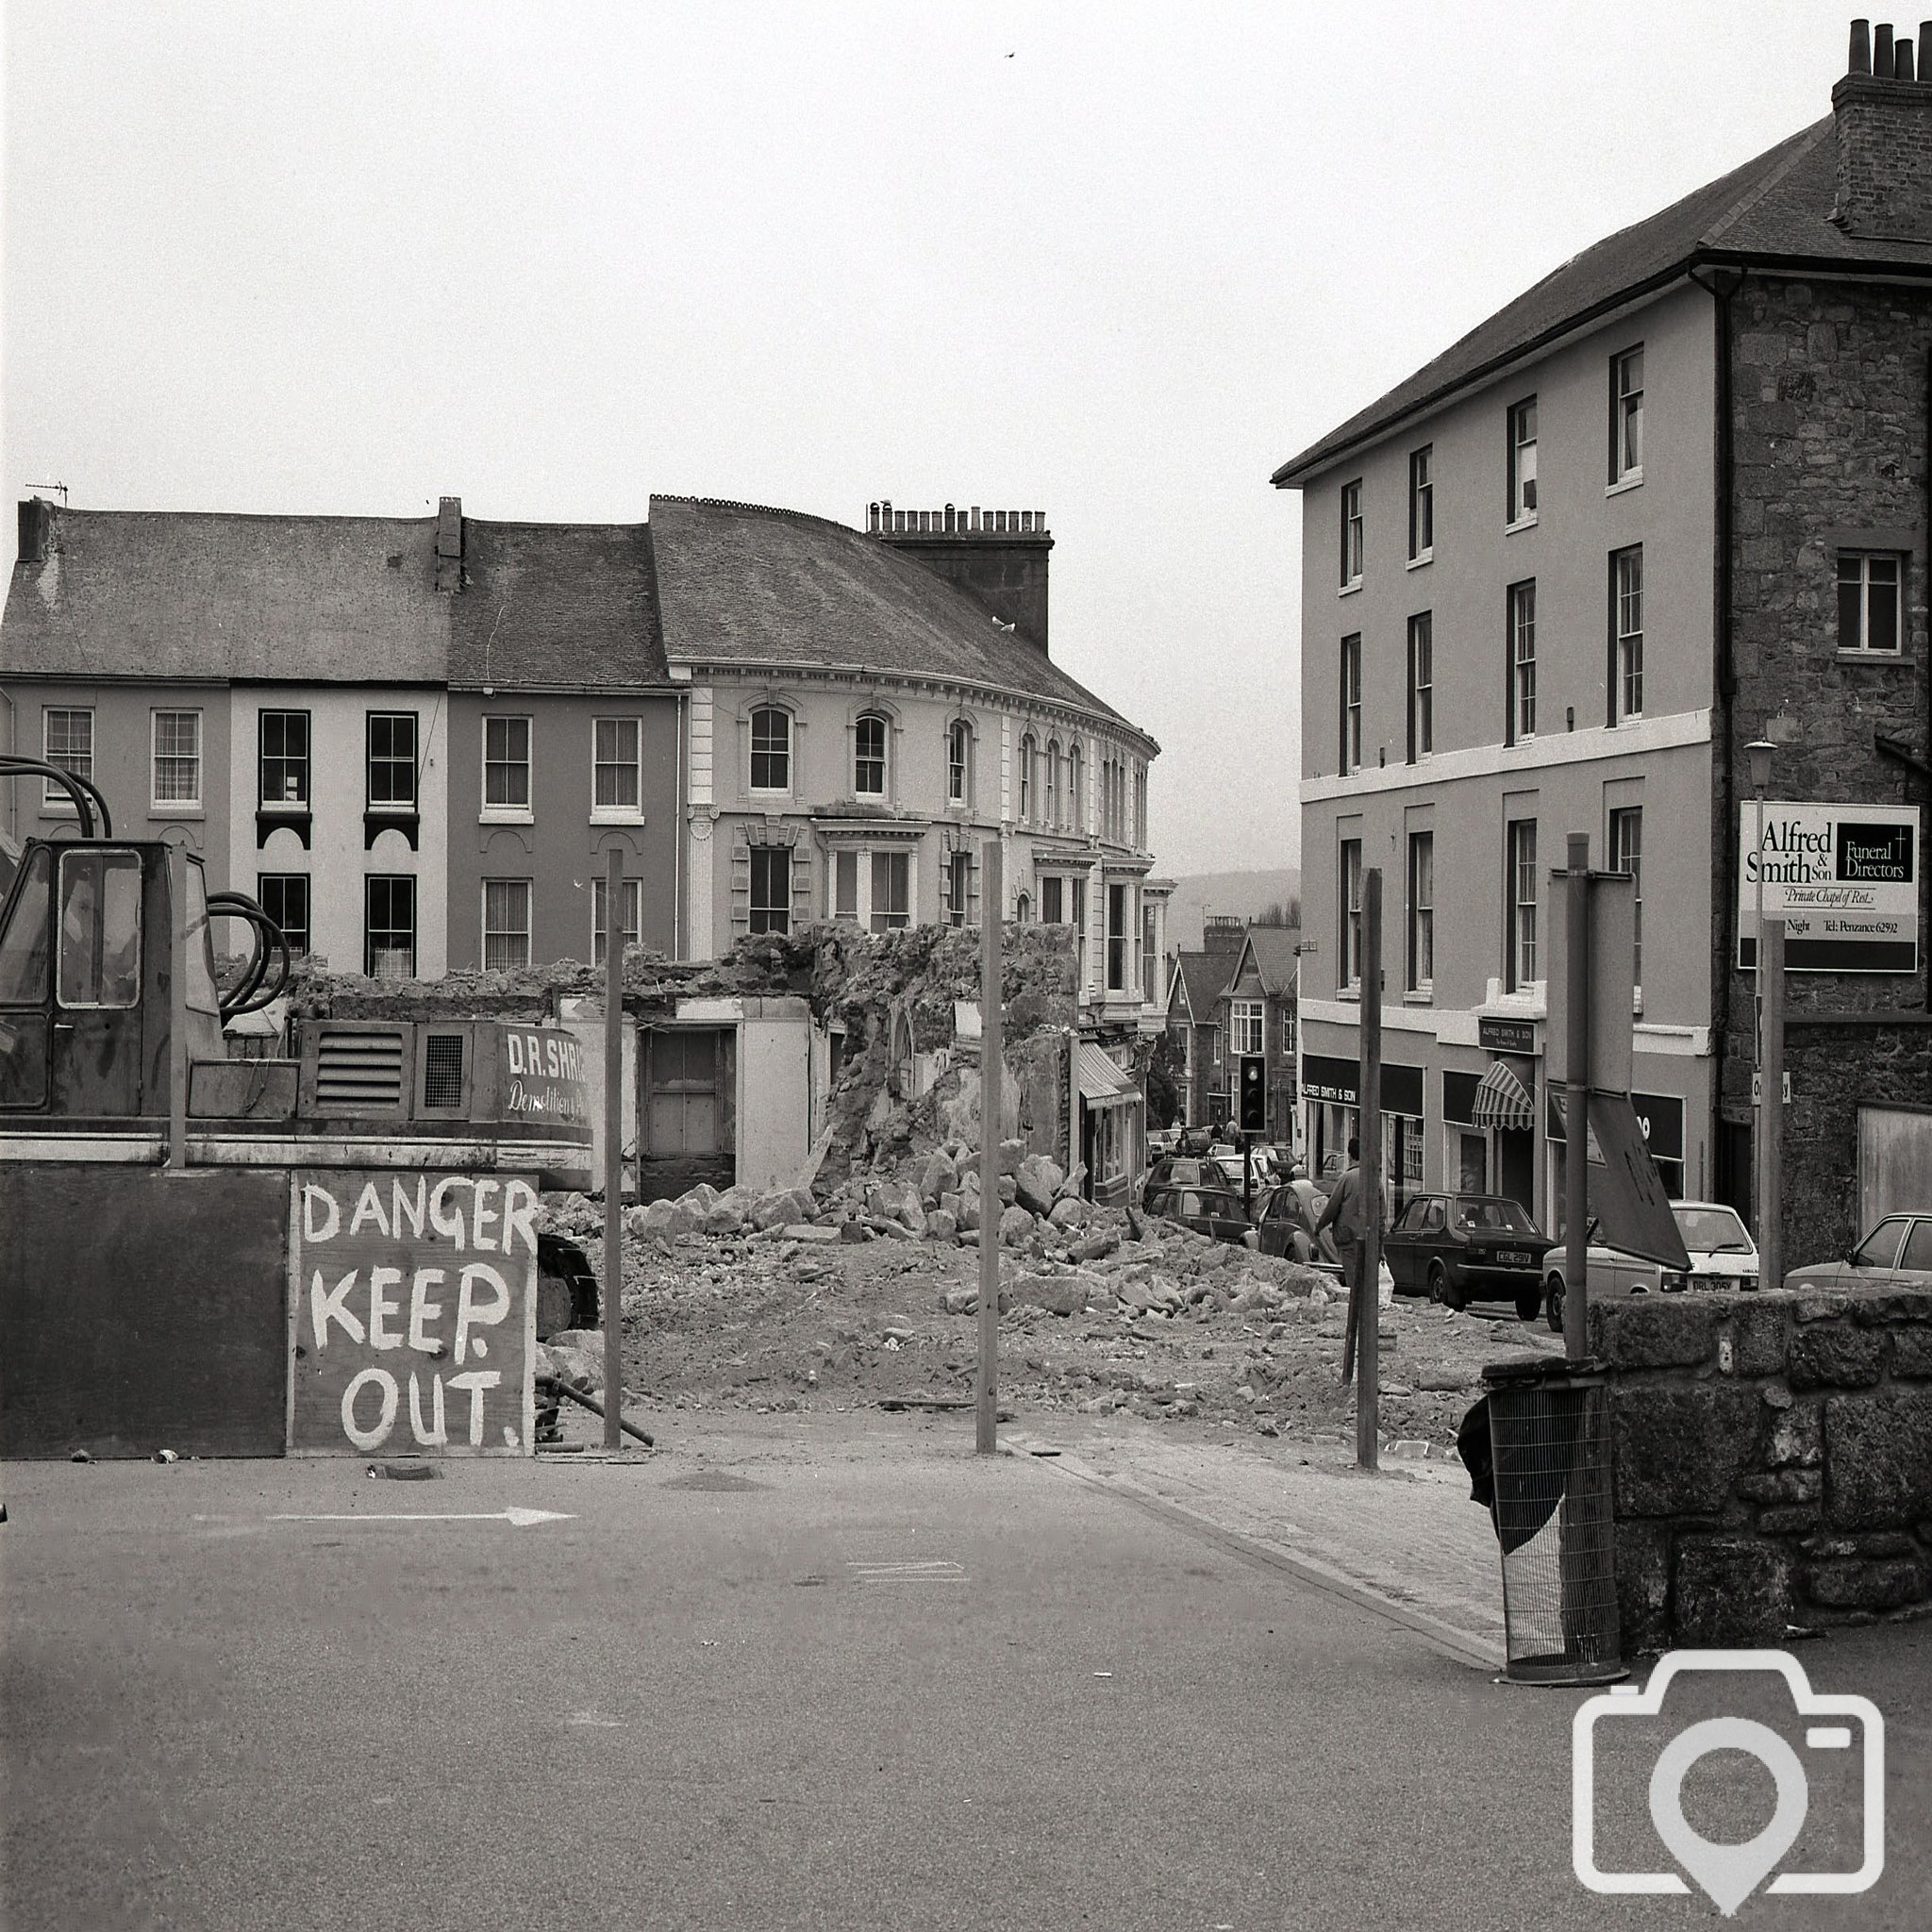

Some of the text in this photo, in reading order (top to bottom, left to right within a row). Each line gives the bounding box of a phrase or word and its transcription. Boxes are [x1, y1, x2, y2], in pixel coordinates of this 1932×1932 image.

[1762, 821, 1831, 853] Alfred
[1846, 841, 1891, 859] Funeral
[1746, 852, 1831, 883] Smith & Son
[1846, 858, 1904, 878] Directors
[1785, 888, 1815, 902] Private
[1816, 888, 1843, 907] Chapel
[1842, 889, 1853, 908] of
[1788, 919, 1810, 935] Night
[1840, 920, 1874, 933] Penzance
[1321, 1086, 1337, 1099] SMITH
[1344, 1090, 1356, 1102] SON
[302, 1174, 540, 1256] DANGER
